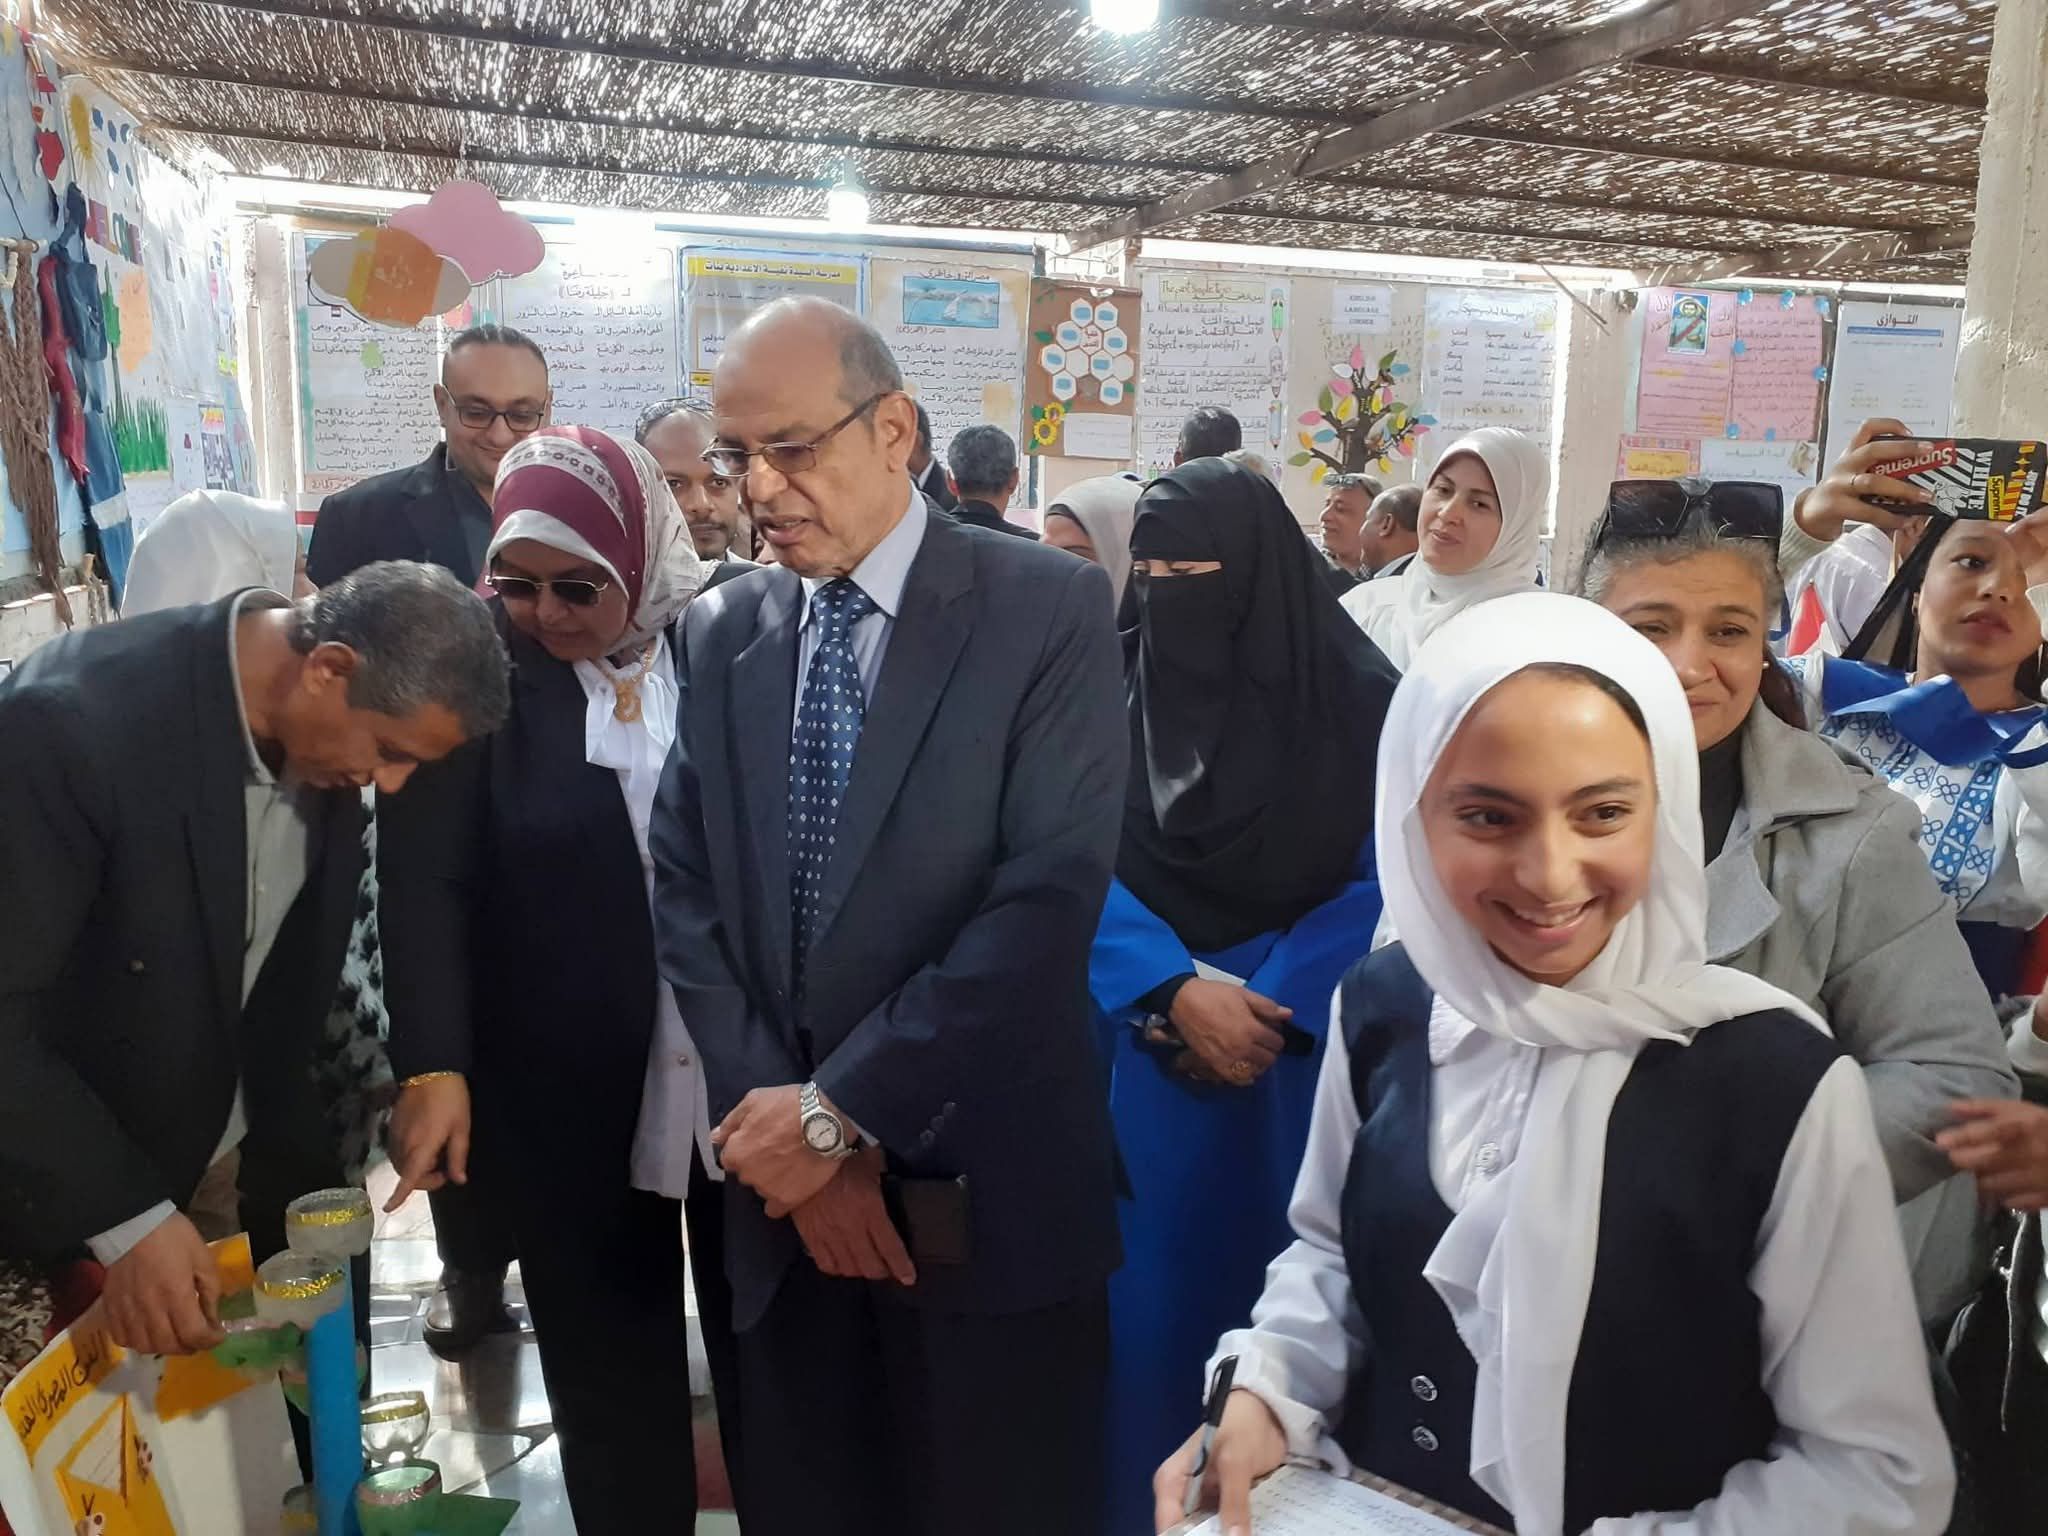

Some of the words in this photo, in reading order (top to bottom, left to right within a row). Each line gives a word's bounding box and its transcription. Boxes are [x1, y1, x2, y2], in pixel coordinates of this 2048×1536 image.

[705, 260, 725, 271] بنات
[764, 264, 788, 276] نفيسة
[789, 265, 815, 277] السيدة
[816, 269, 841, 279] مدرسة
[1147, 322, 1176, 338] Regular
[1875, 447, 1953, 477] Supreme
[1967, 450, 1994, 510] WHITE
